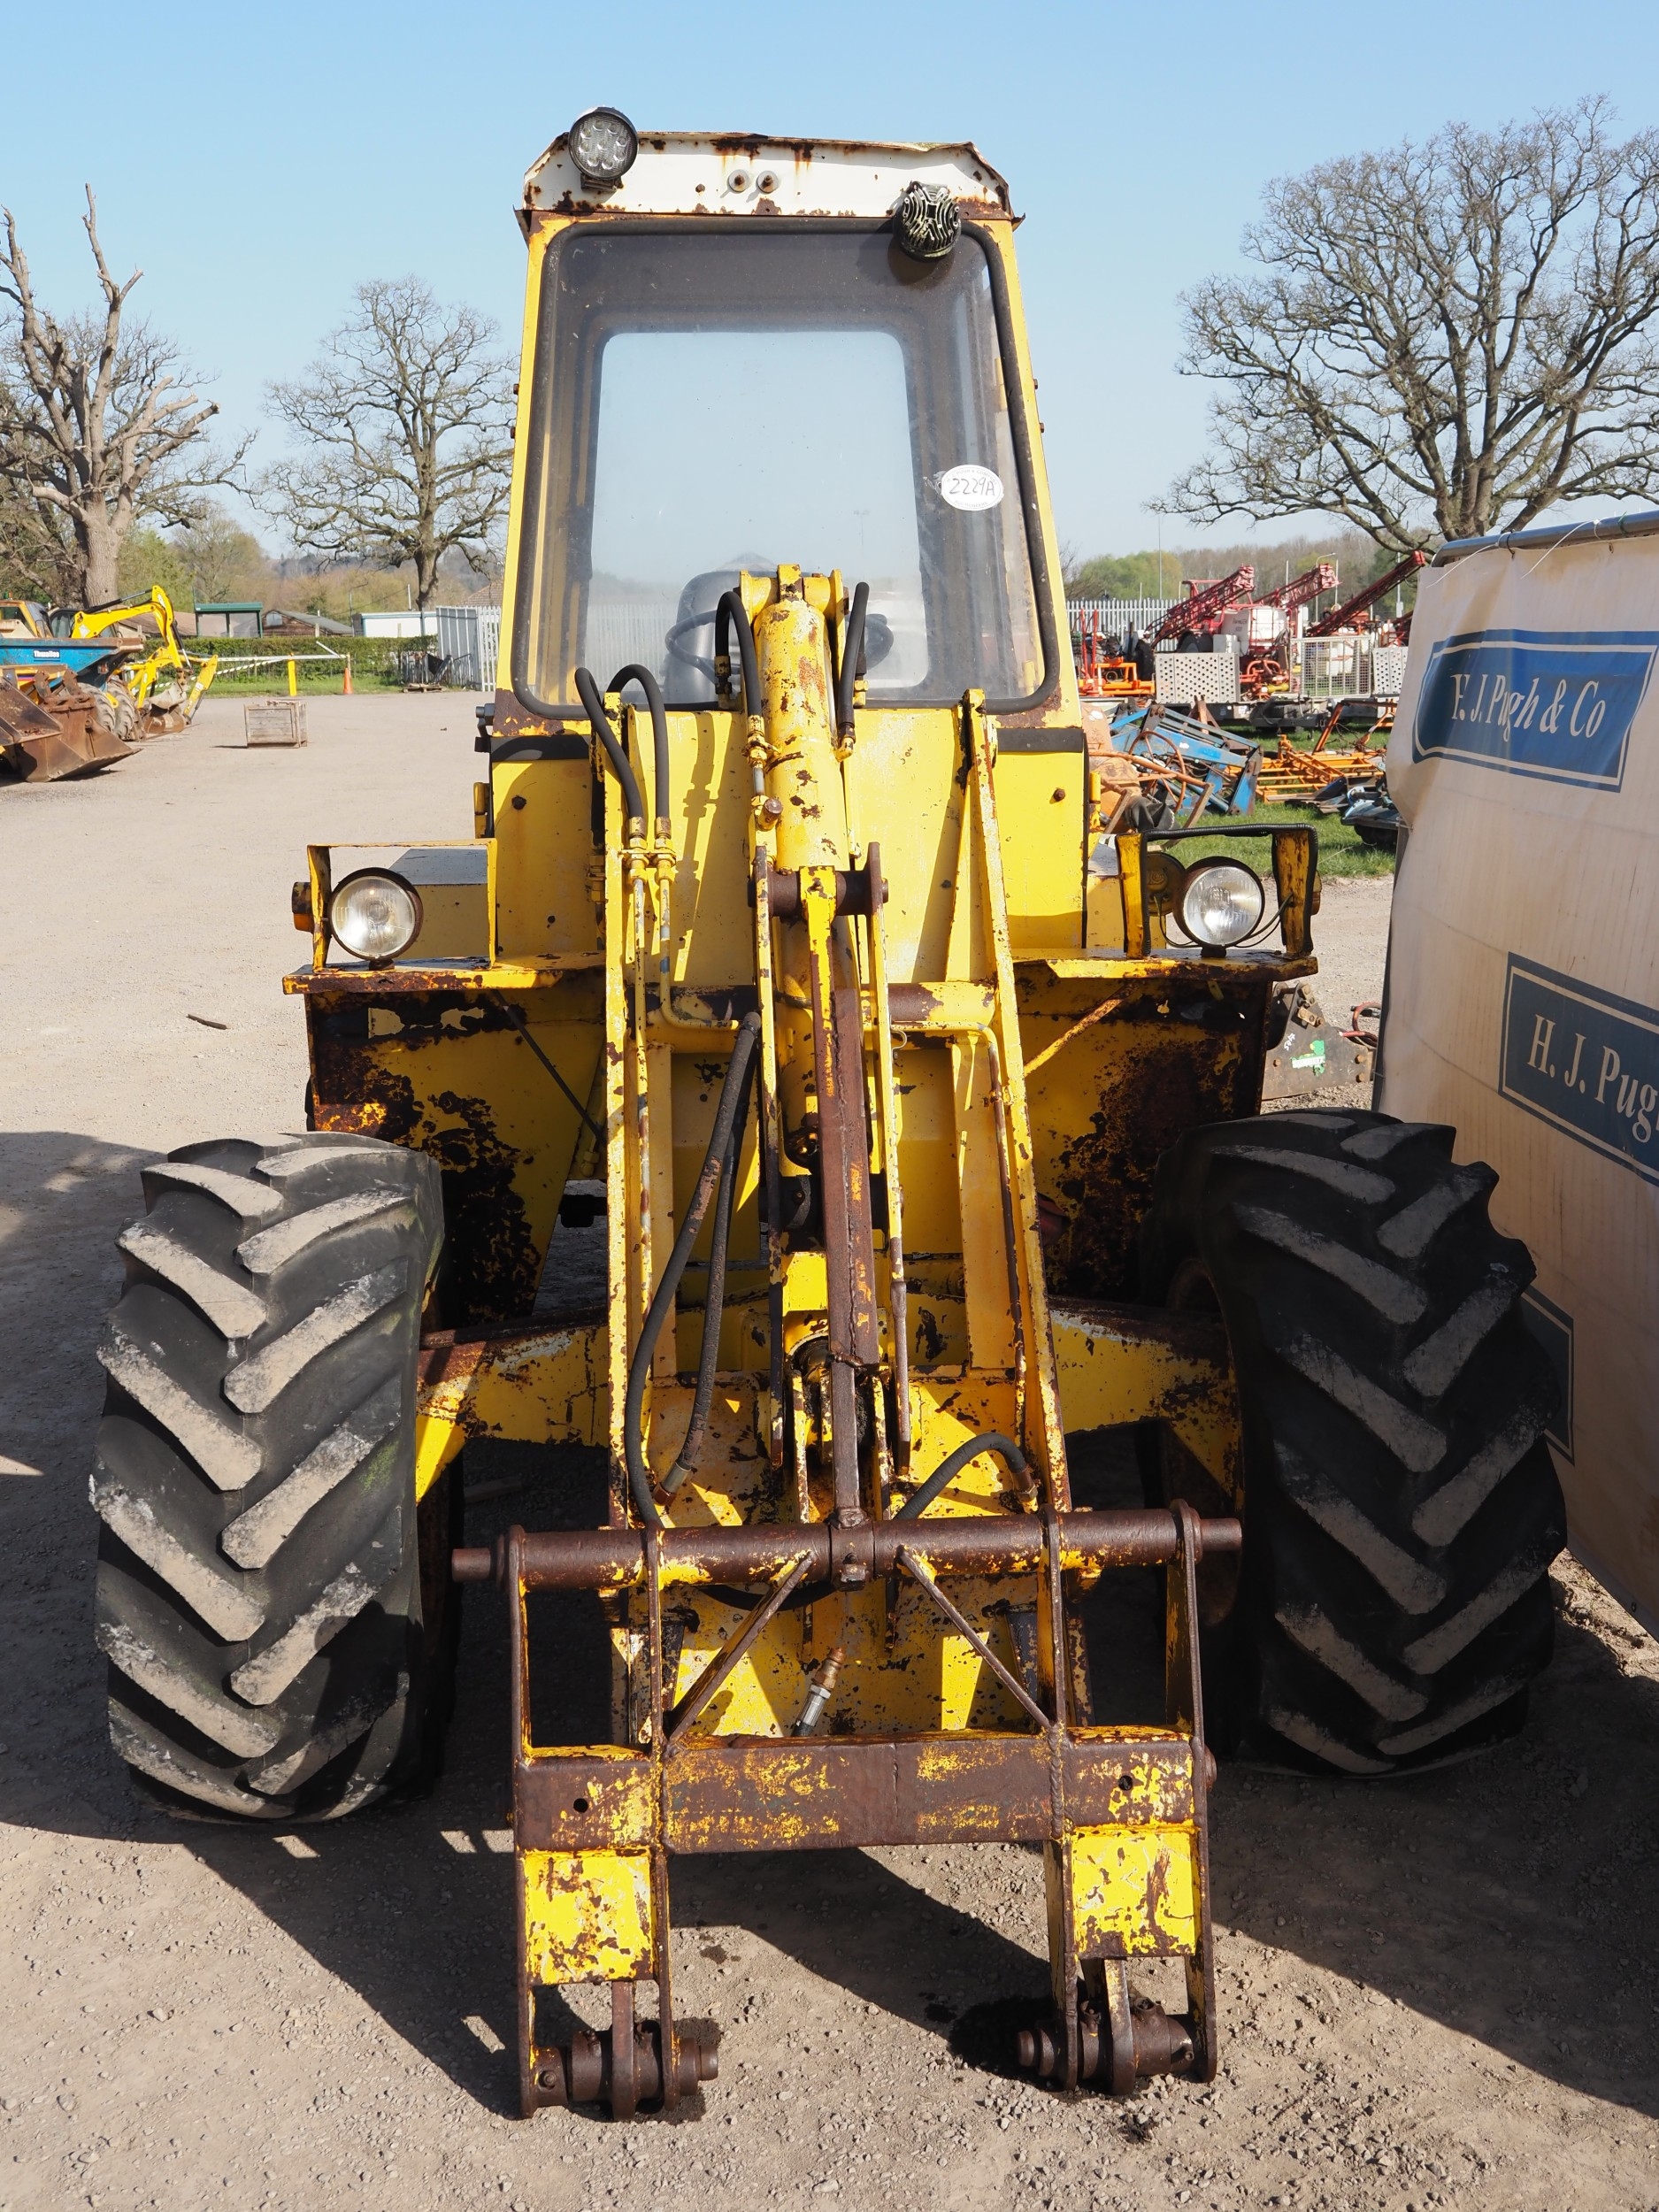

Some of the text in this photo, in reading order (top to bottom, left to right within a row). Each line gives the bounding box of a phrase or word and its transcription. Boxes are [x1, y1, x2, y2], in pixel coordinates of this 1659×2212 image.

[949, 477, 995, 496] 2229A
[1485, 674, 1540, 742] Pugh
[1539, 679, 1568, 734] &
[1570, 680, 1606, 739] Co
[1527, 1013, 1659, 1144] H. J. Pug
